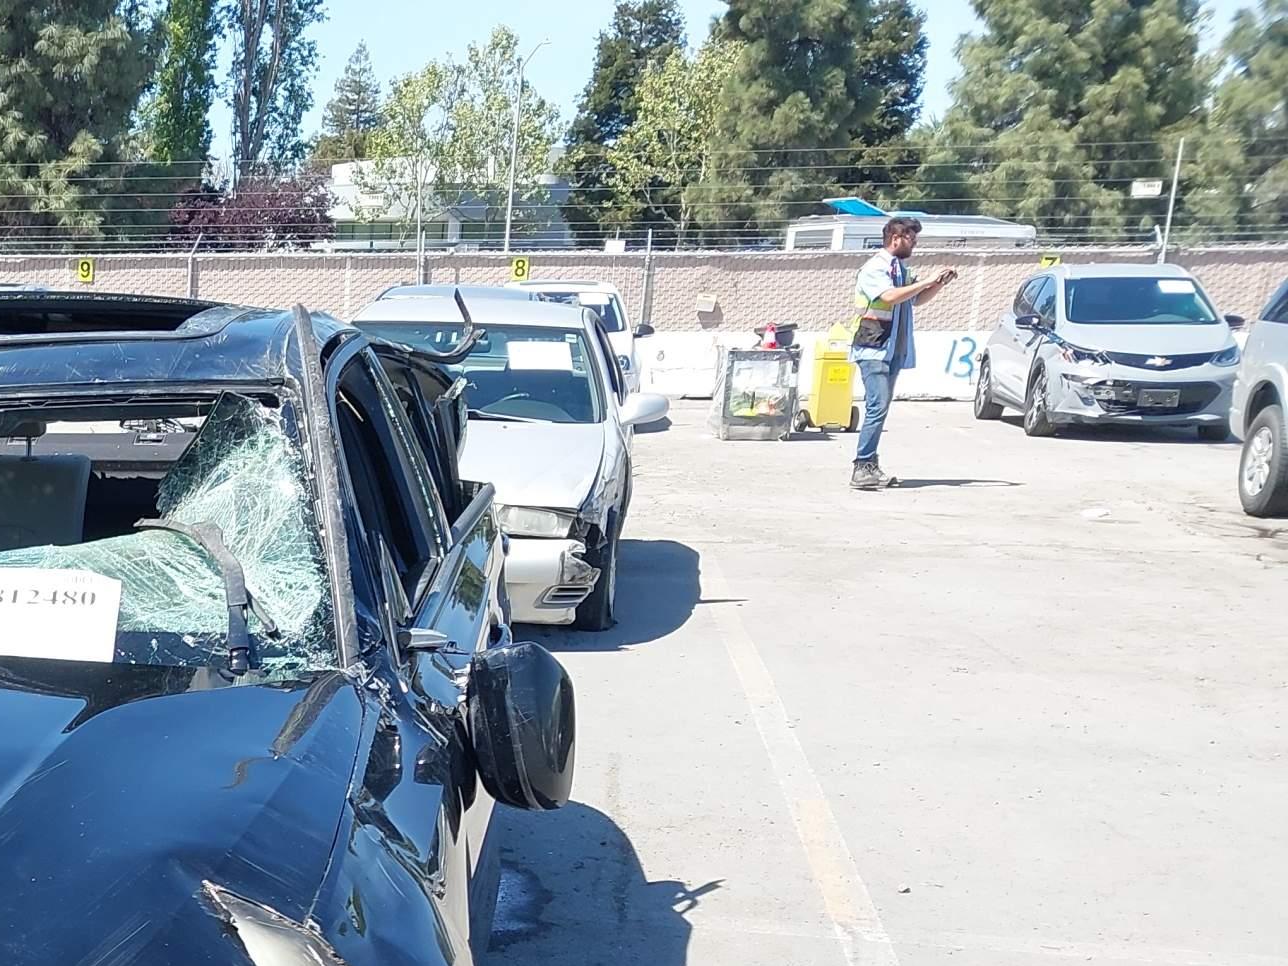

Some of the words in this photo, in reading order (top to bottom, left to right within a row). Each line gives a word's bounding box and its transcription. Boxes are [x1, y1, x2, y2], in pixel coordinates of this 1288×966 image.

[80, 261, 91, 279] 9
[514, 259, 526, 277] 8
[1044, 256, 1058, 267] 7
[944, 336, 977, 379] 13
